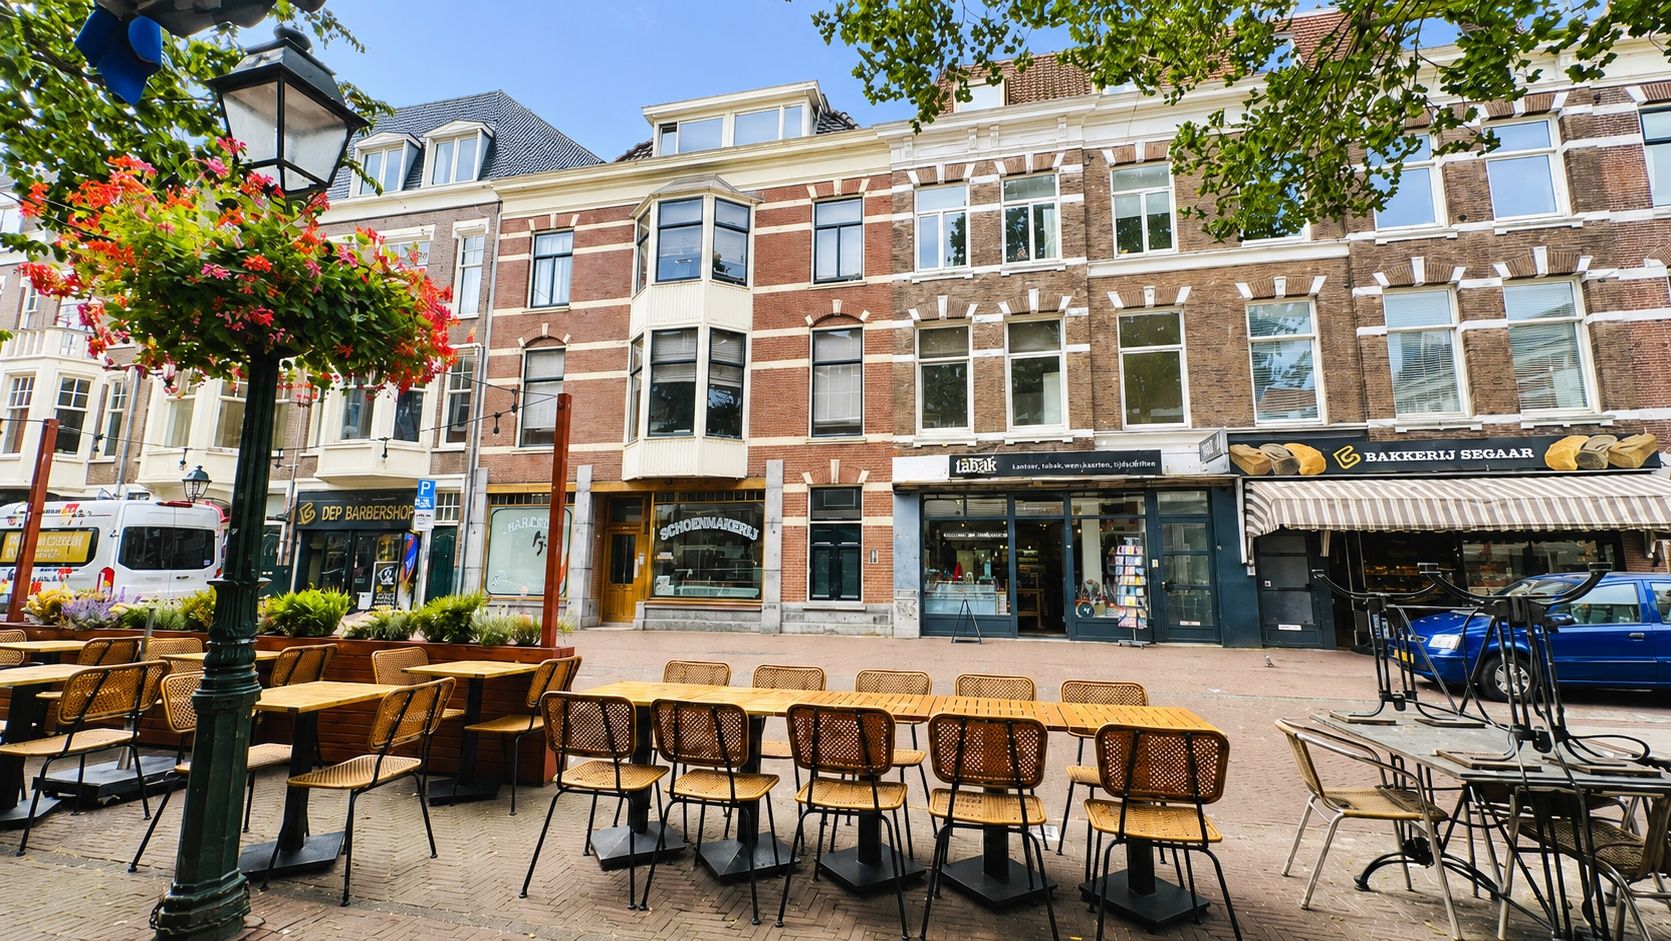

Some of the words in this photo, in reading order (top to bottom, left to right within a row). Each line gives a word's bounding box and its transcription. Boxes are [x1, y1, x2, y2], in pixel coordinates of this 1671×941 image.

[1363, 449, 1456, 463] BAKKERIJ
[1460, 447, 1535, 460] SEGAAR
[955, 456, 998, 474] tabak
[420, 481, 431, 496] P
[321, 505, 343, 521] DEP
[659, 516, 760, 541] SCHOENMAKERIJ
